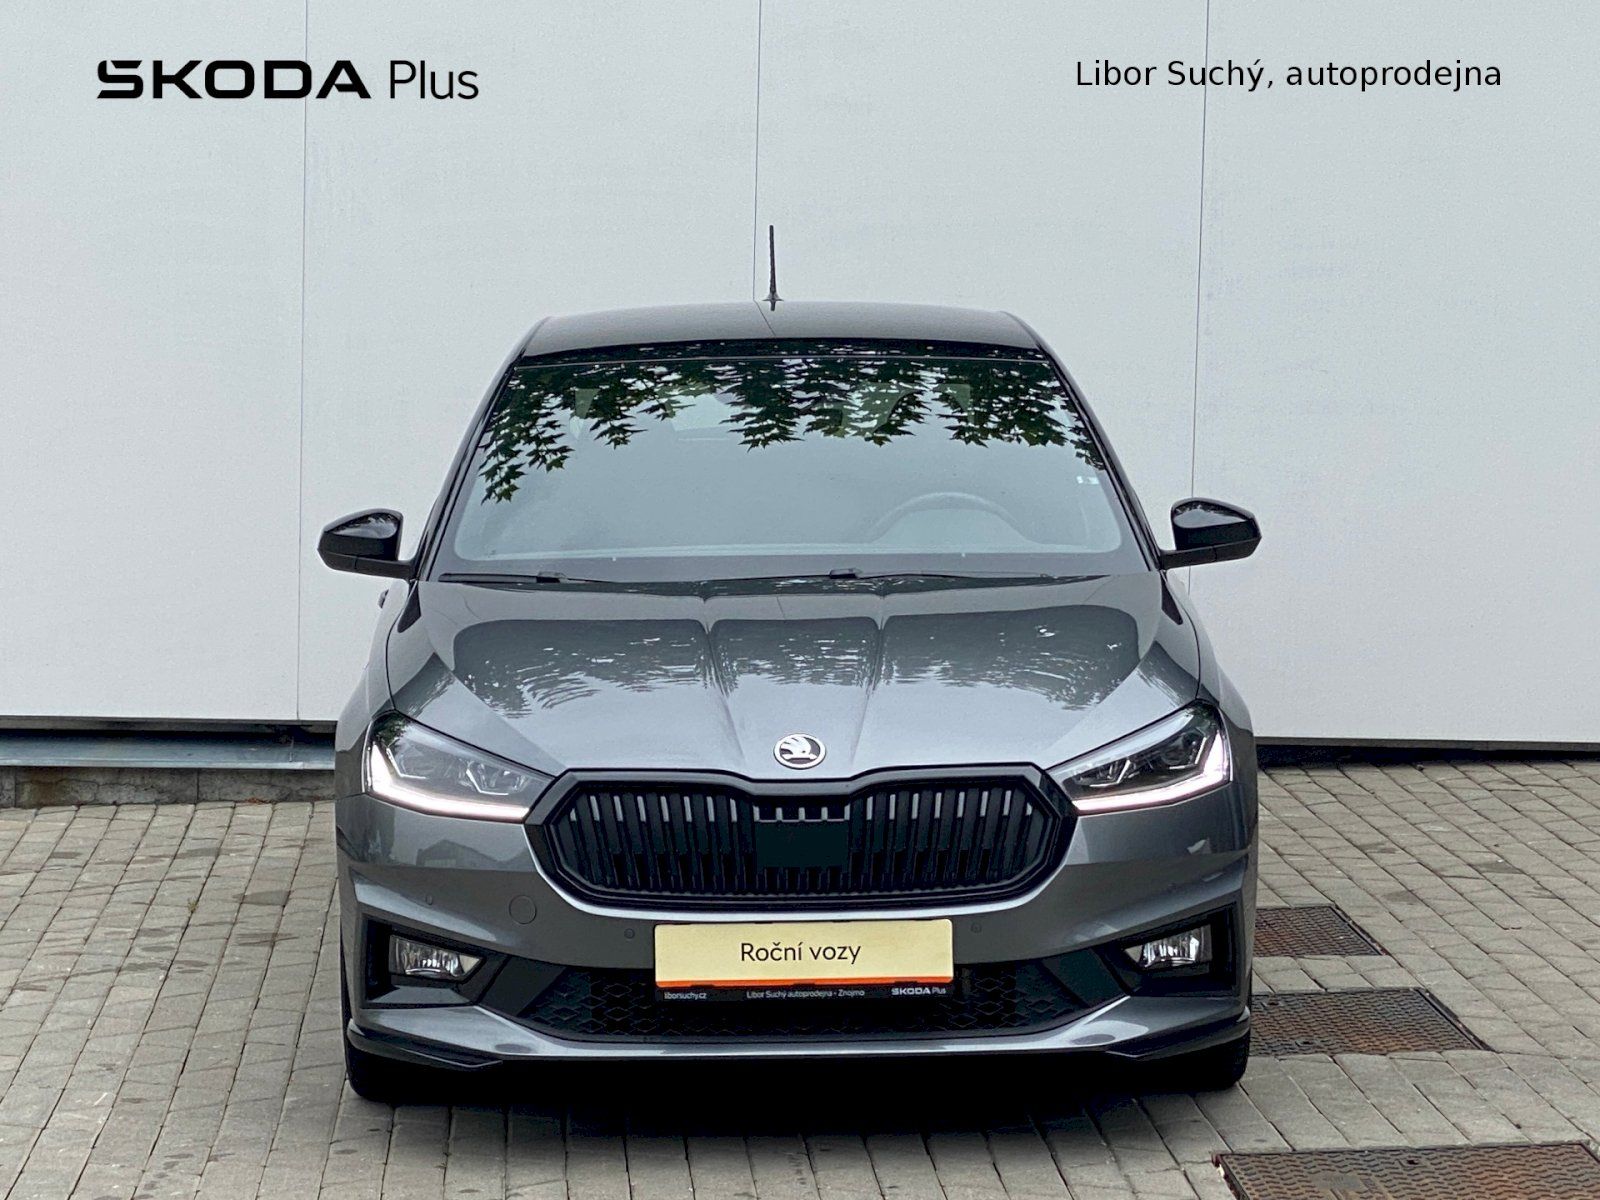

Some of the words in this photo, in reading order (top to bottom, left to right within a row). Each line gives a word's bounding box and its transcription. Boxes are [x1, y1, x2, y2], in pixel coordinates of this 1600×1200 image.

[741, 941, 803, 961] Roční
[809, 945, 861, 965] vozy
[932, 986, 946, 994] Plus
